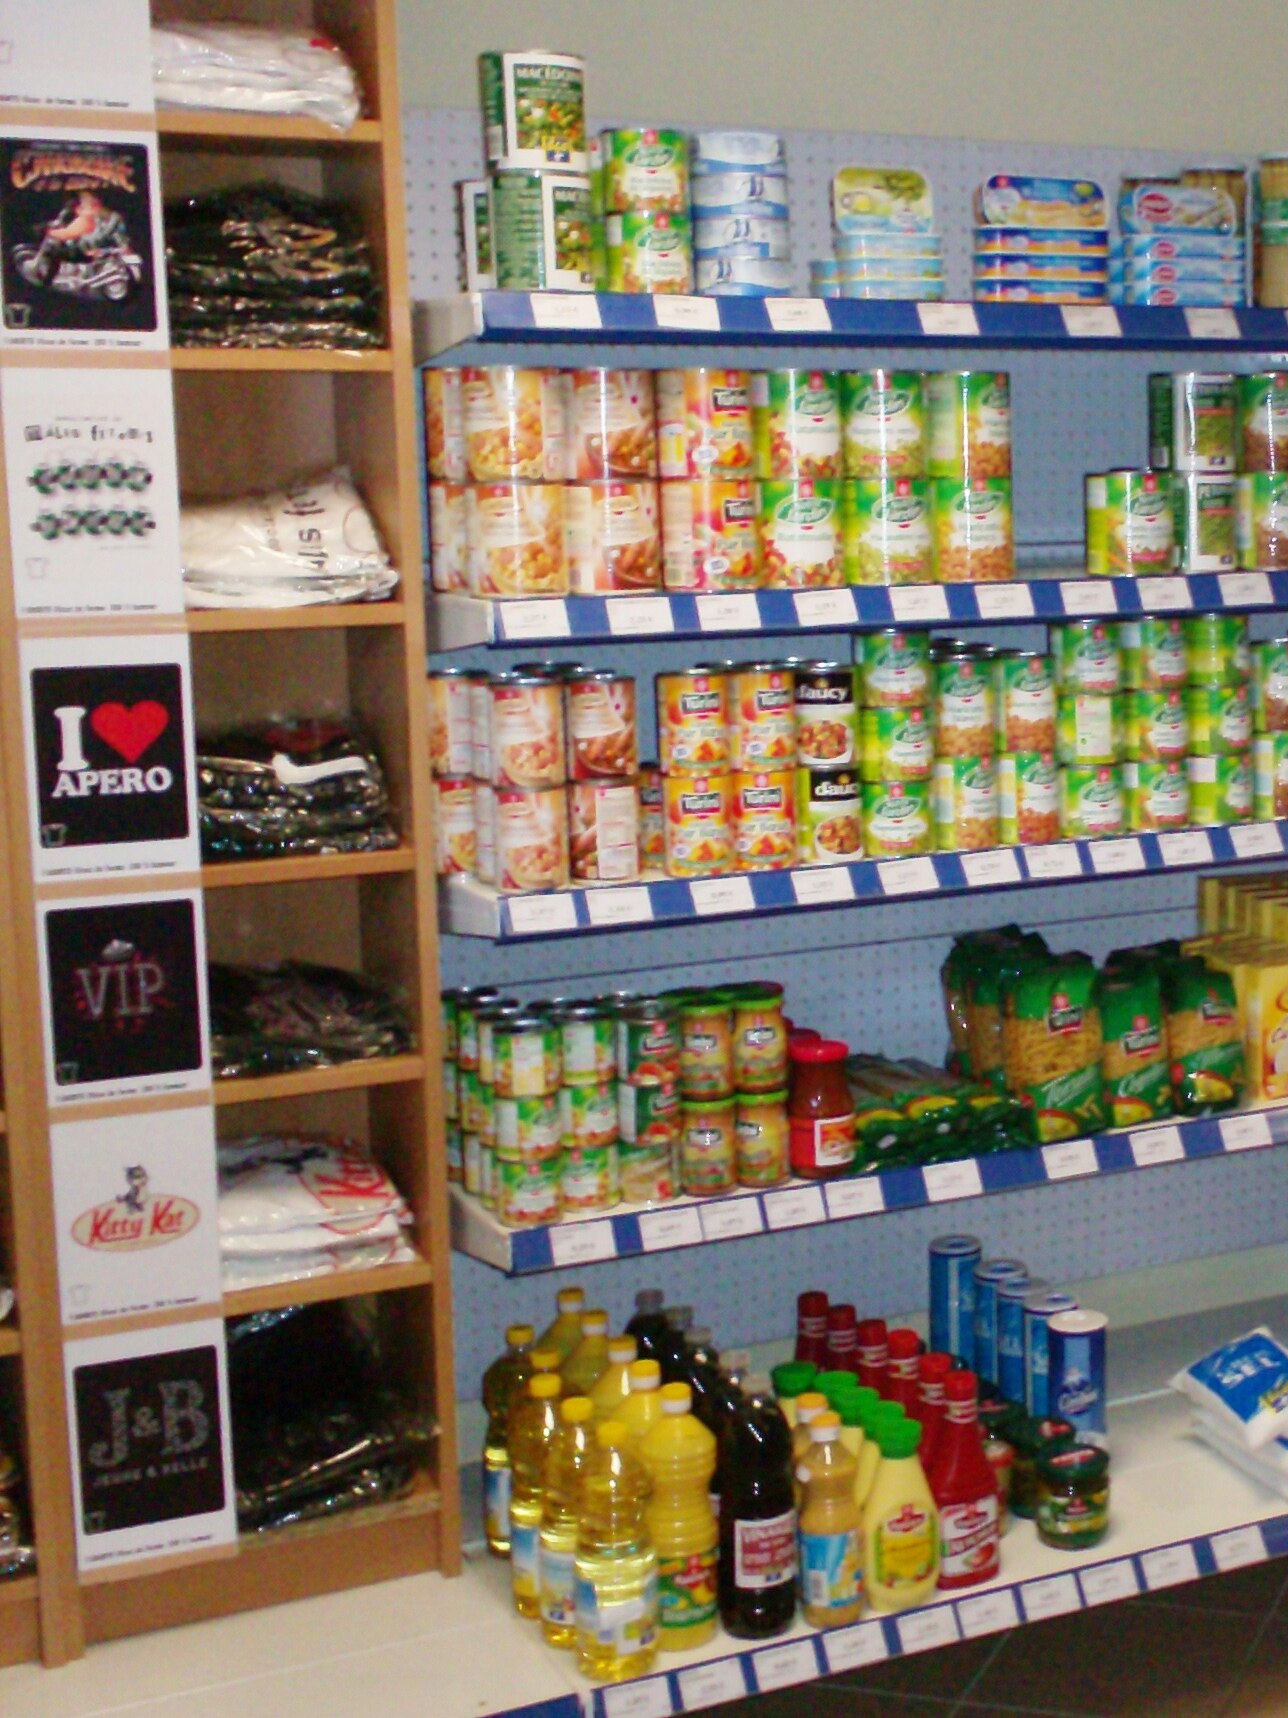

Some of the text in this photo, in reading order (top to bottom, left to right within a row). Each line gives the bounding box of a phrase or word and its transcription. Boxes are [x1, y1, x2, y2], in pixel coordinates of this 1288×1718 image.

[53, 706, 89, 772] I
[52, 765, 173, 799] APERO
[815, 783, 860, 797] d'auc
[75, 960, 166, 1022] VIP
